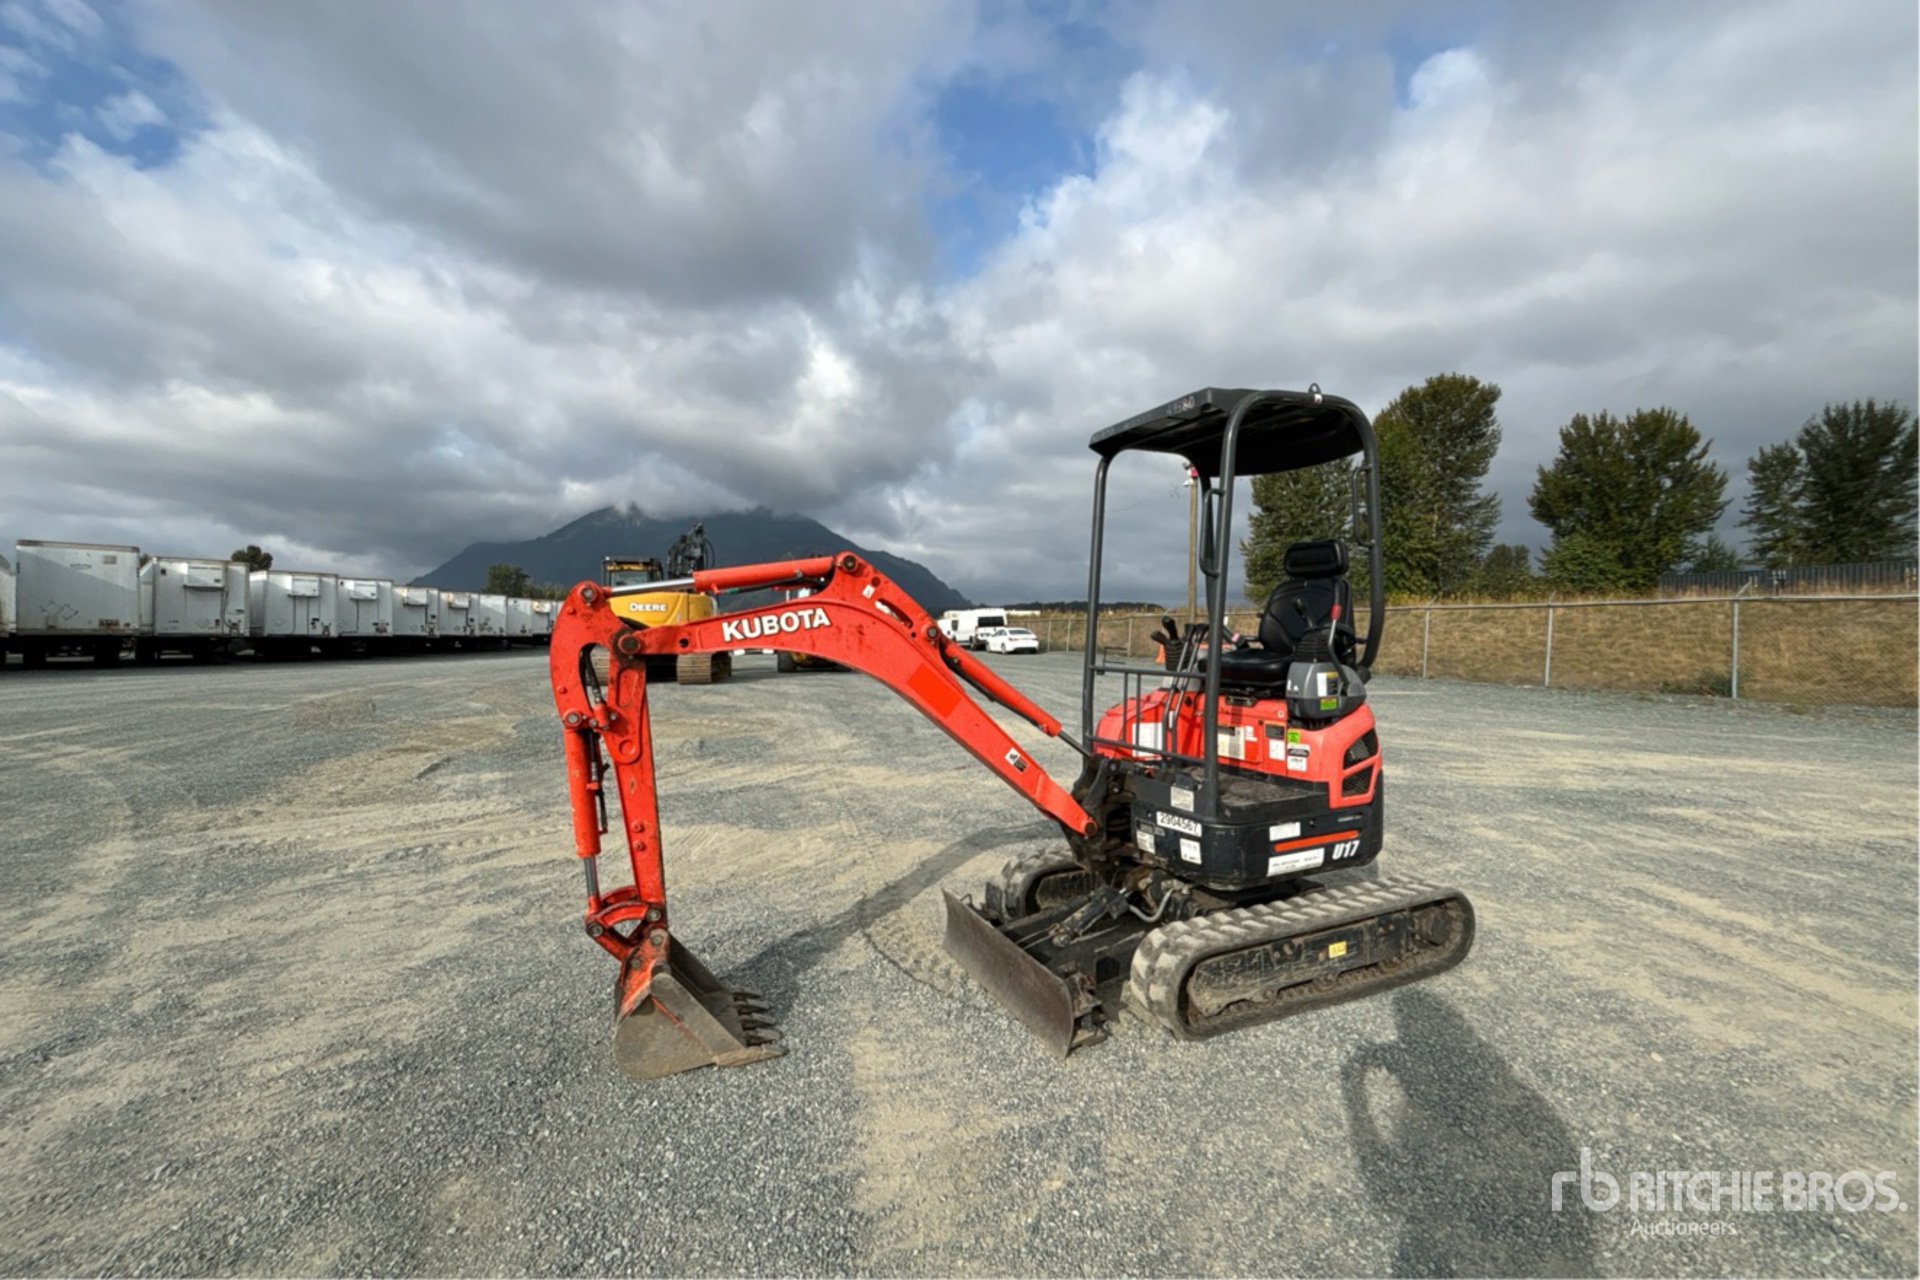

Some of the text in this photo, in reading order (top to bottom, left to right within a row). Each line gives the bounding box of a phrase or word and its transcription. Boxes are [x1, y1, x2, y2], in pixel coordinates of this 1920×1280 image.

[629, 602, 667, 612] DEERE
[722, 608, 831, 642] KUBOTA
[1332, 840, 1360, 860] U17
